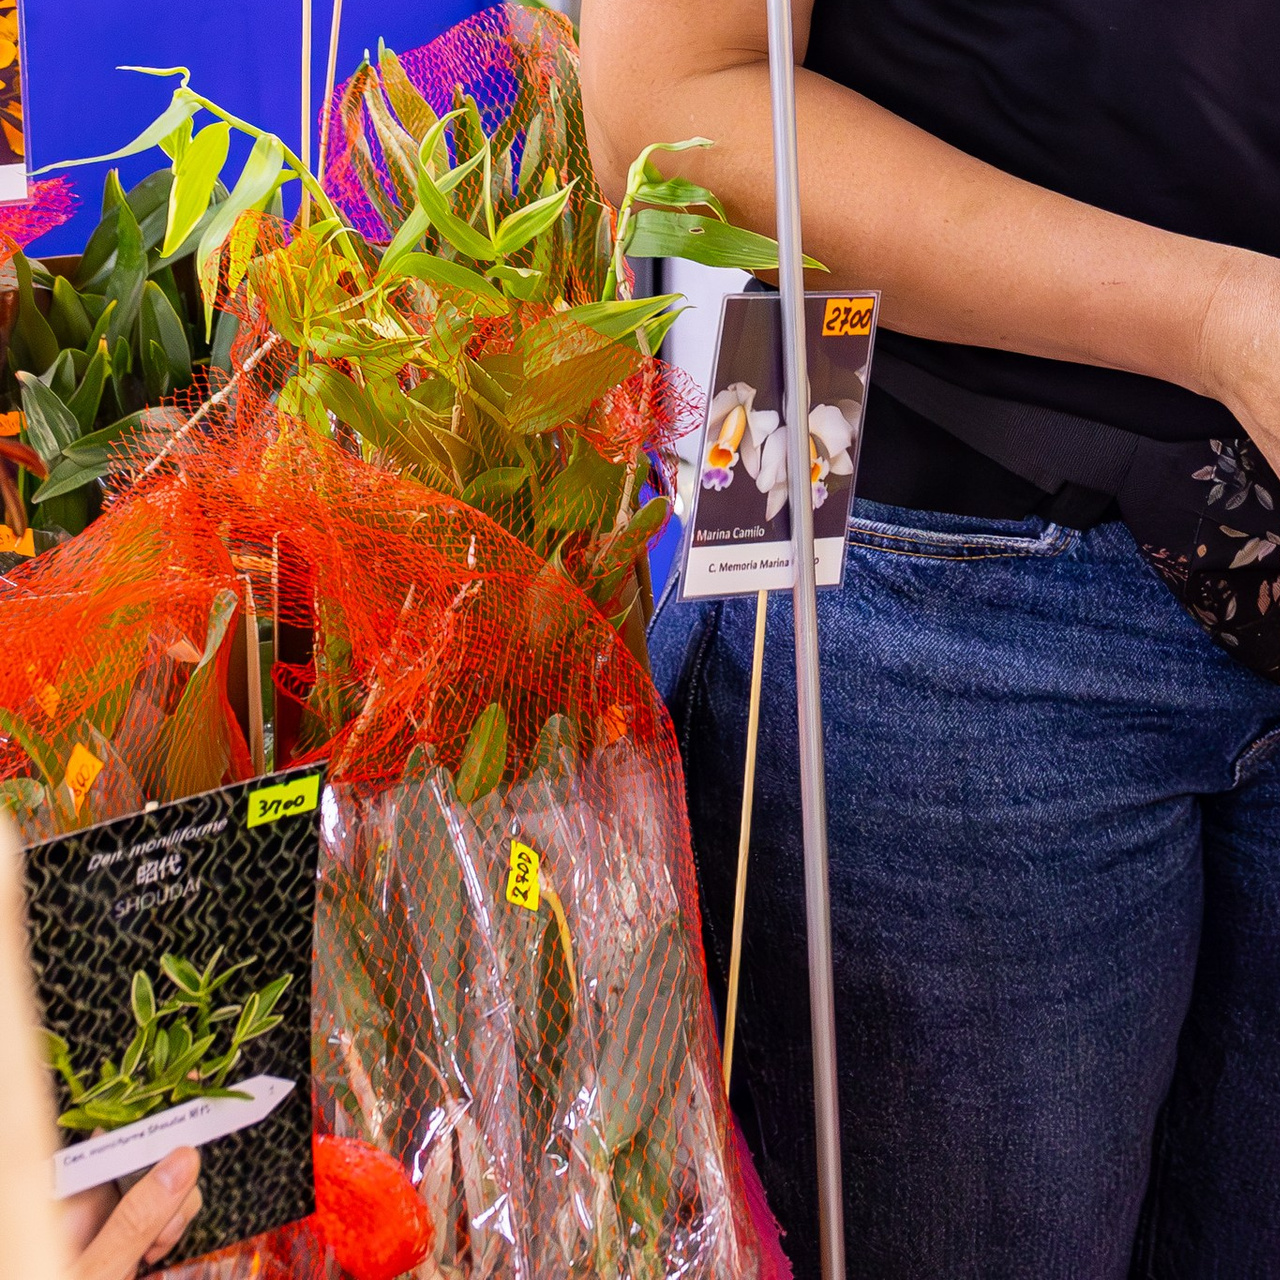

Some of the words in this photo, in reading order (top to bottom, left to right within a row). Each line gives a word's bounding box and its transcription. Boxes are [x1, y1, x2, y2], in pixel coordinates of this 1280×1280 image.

[826, 306, 872, 332] 2700
[697, 528, 731, 541] Marina
[733, 525, 765, 539] Camilo
[708, 563, 716, 573] C.
[719, 559, 757, 572] Memoria
[760, 557, 789, 569] Marina
[259, 795, 305, 818] 3700
